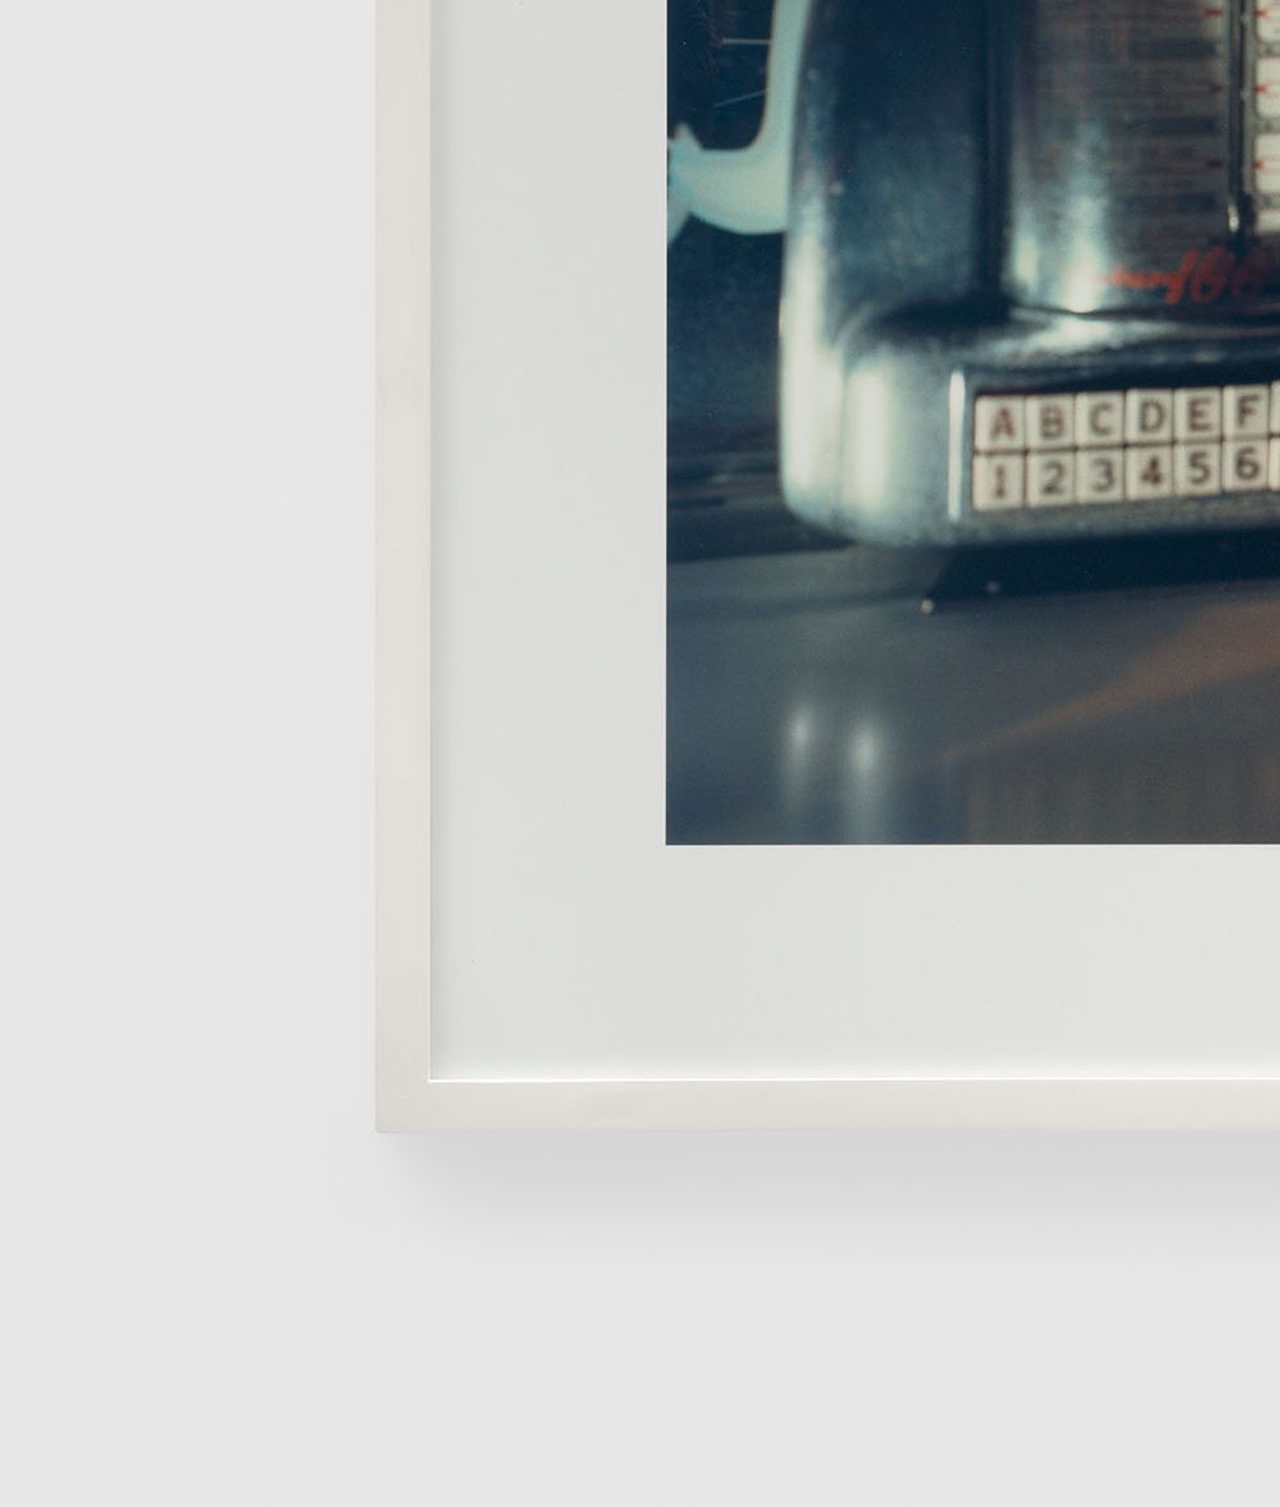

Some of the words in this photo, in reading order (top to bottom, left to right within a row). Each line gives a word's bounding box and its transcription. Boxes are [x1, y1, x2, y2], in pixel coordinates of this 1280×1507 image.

[990, 408, 1015, 439] A
[1041, 407, 1063, 438] B
[1090, 402, 1113, 436] C
[1138, 400, 1165, 434] D
[1188, 397, 1212, 432] E
[1238, 395, 1260, 428] F
[992, 466, 1006, 499] 1
[1043, 462, 1065, 494] 2
[1092, 459, 1115, 492] 3
[1140, 455, 1162, 487] 4
[1188, 451, 1210, 484] 5
[1235, 447, 1259, 480] 6
